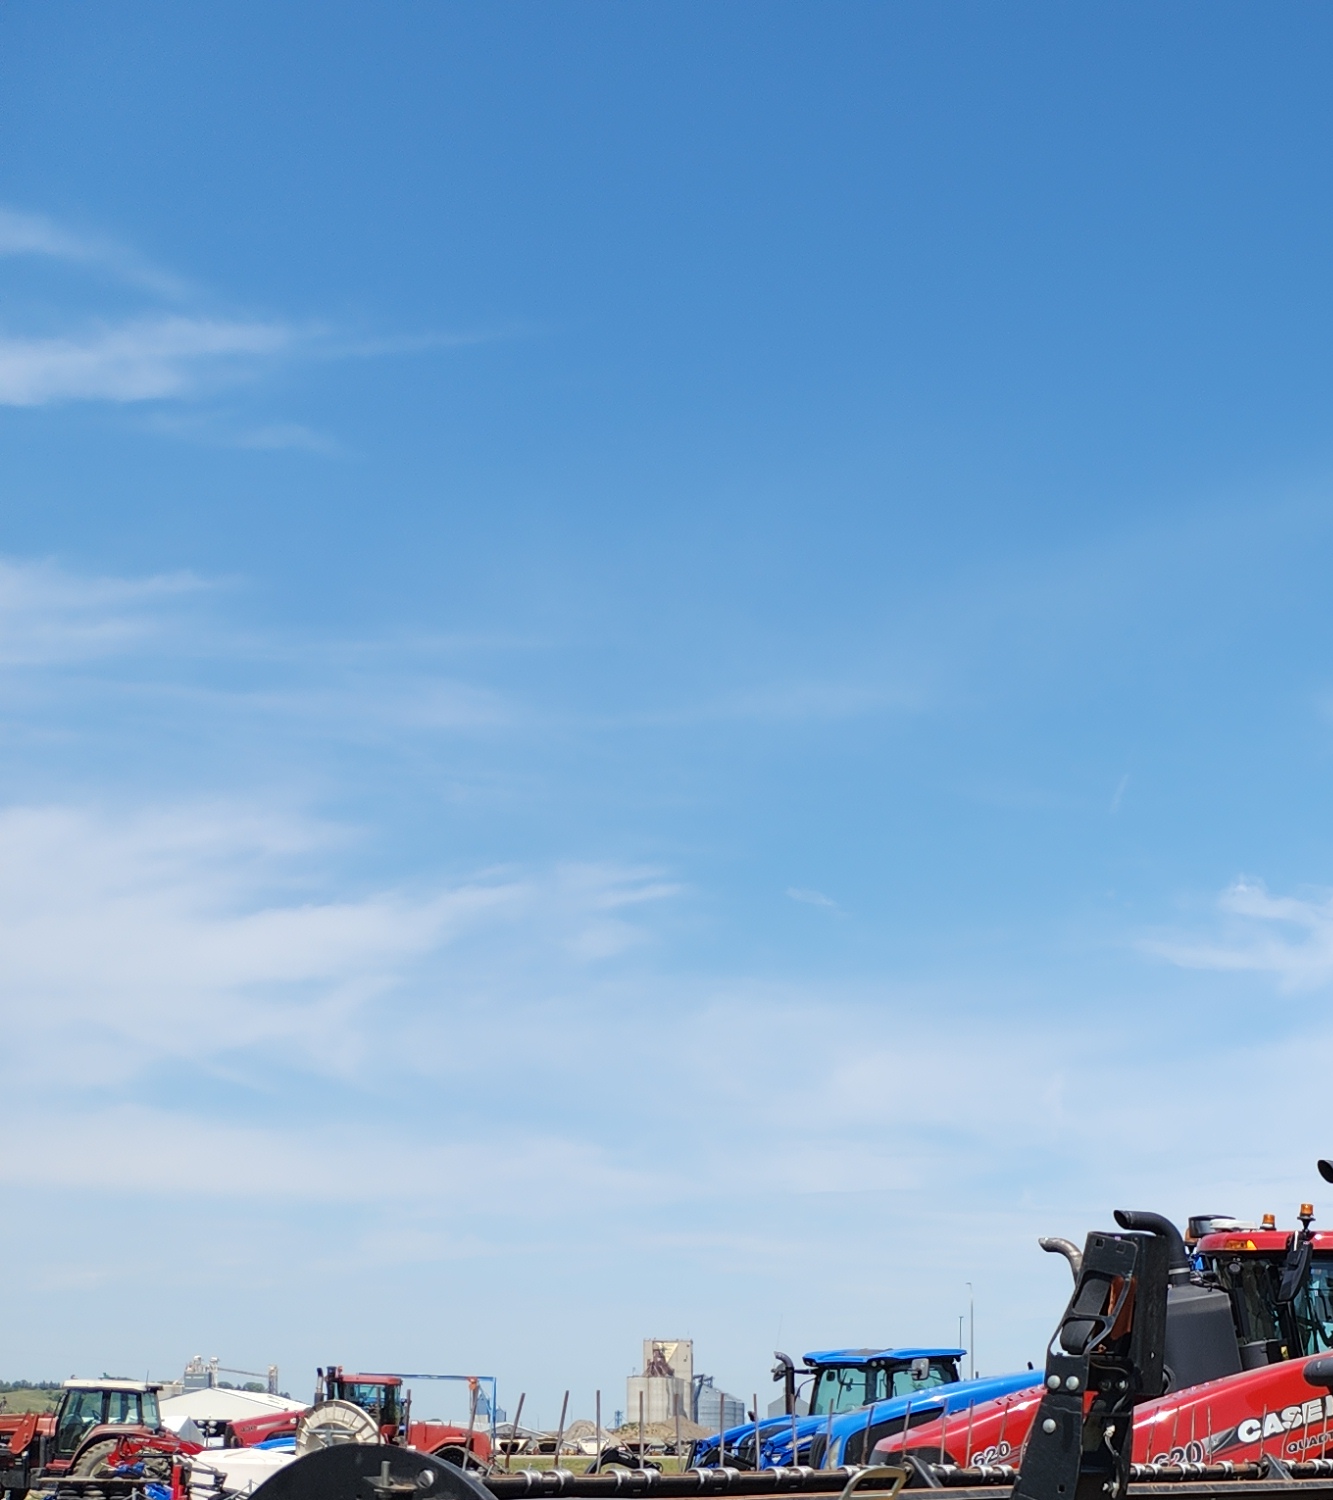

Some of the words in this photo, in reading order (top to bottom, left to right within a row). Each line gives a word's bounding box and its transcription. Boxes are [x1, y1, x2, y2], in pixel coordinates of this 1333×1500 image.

[1237, 1397, 1322, 1443] CASE
[971, 1440, 1011, 1467] 620
[1151, 1440, 1205, 1467] 620
